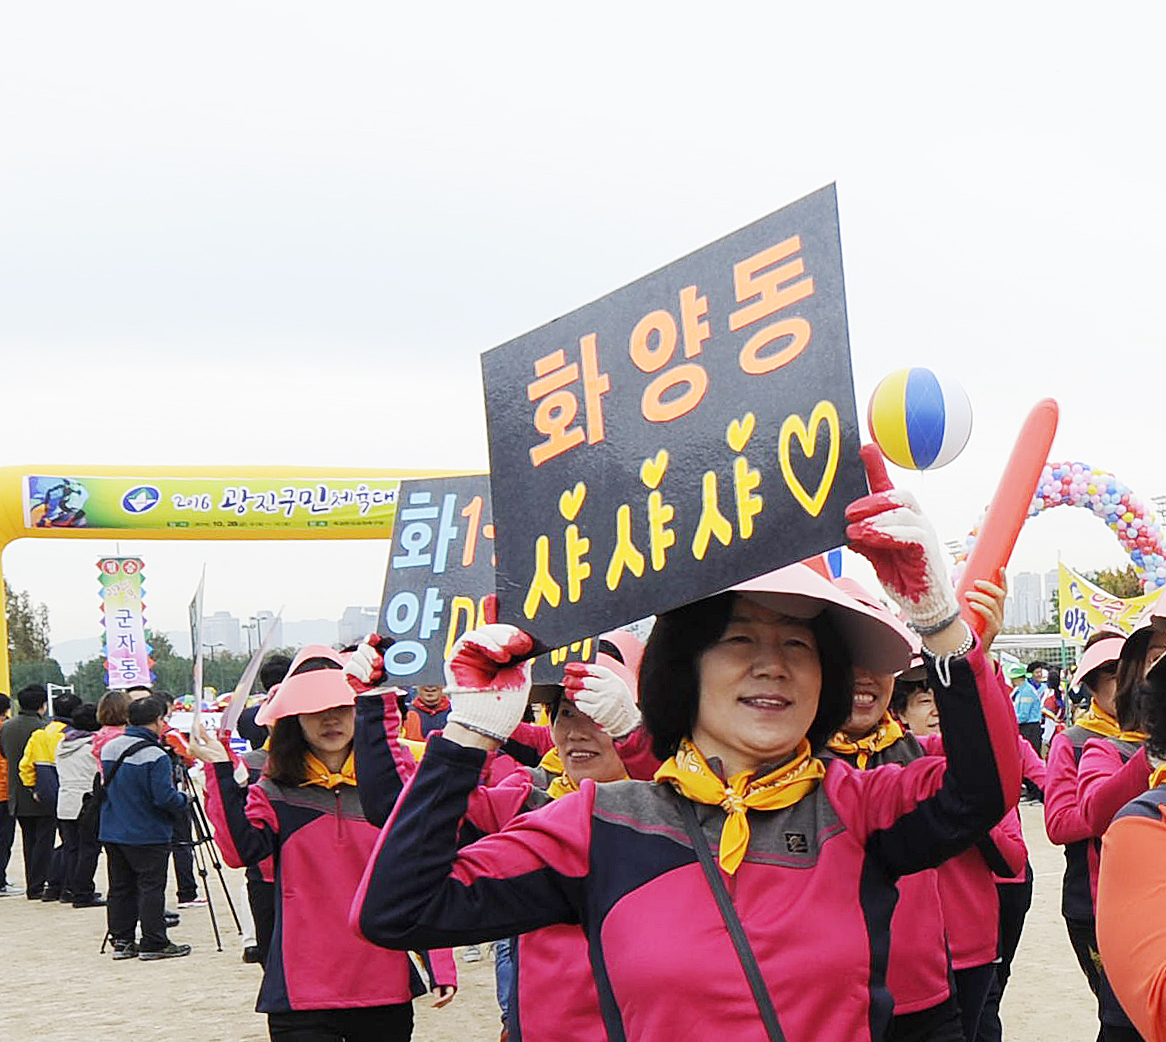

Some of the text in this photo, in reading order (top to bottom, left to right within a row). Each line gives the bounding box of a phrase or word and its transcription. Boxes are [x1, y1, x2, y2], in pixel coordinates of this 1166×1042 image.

[527, 235, 815, 467] 화양동
[173, 495, 211, 510] 2016
[523, 456, 764, 620] 샤샤샤
[115, 609, 139, 680] 군자동
